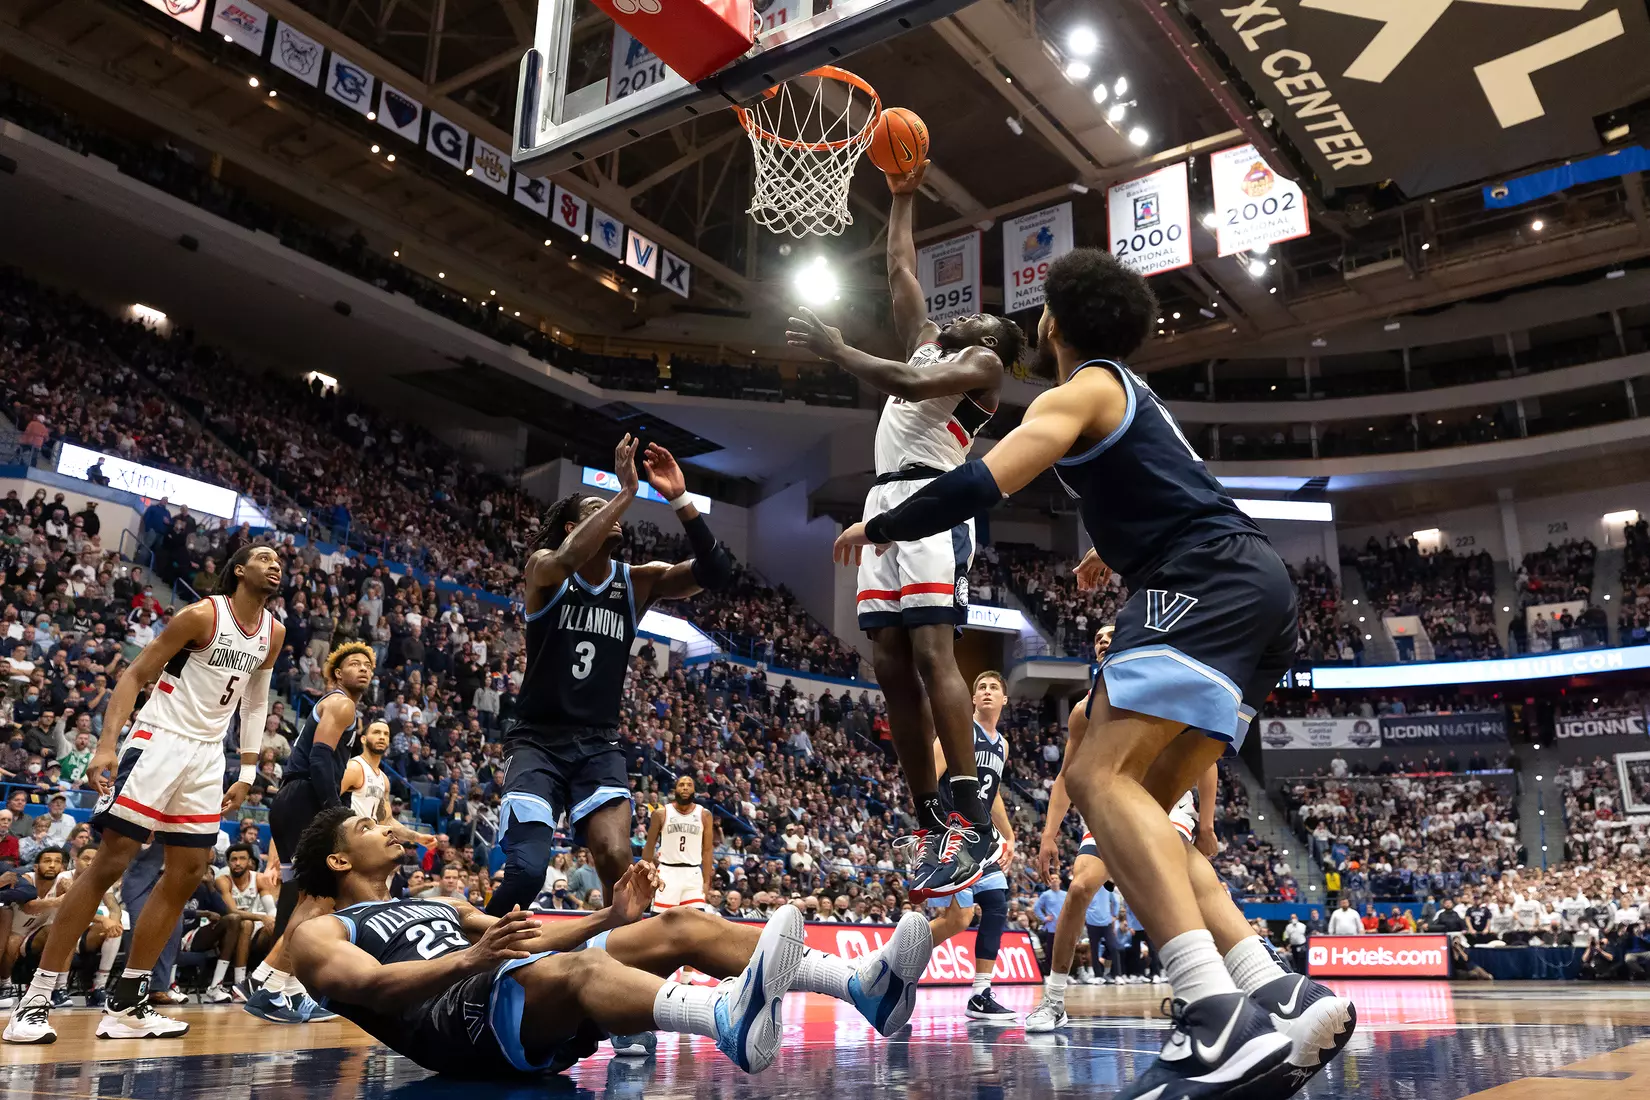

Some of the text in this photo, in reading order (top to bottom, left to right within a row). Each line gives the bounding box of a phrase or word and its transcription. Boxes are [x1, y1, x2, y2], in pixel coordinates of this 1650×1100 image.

[1220, 0, 1374, 171] XL CENTER
[431, 122, 463, 162] G
[1227, 192, 1296, 226] 2002
[632, 236, 654, 267] V
[1116, 224, 1182, 257] 2000
[1124, 248, 1175, 266] NATIONAL
[1135, 256, 1181, 273] AMPIONS
[666, 257, 687, 290] X
[1012, 262, 1049, 287] 199
[925, 285, 972, 313] 1995
[1012, 295, 1046, 310] CHAMP
[1016, 285, 1046, 299] NATIO
[1547, 522, 1568, 534] 224
[1456, 536, 1475, 548] 223
[558, 604, 624, 642] VLLANOVA
[968, 606, 1001, 625] inity
[572, 641, 596, 680] 3
[220, 675, 240, 706] 5
[1384, 724, 1440, 740] UCONN
[1442, 721, 1505, 736] NATIN
[1556, 719, 1627, 738] UCONN
[680, 836, 686, 852] 2
[405, 920, 470, 961] 23
[1331, 946, 1442, 966] Hotels.com
